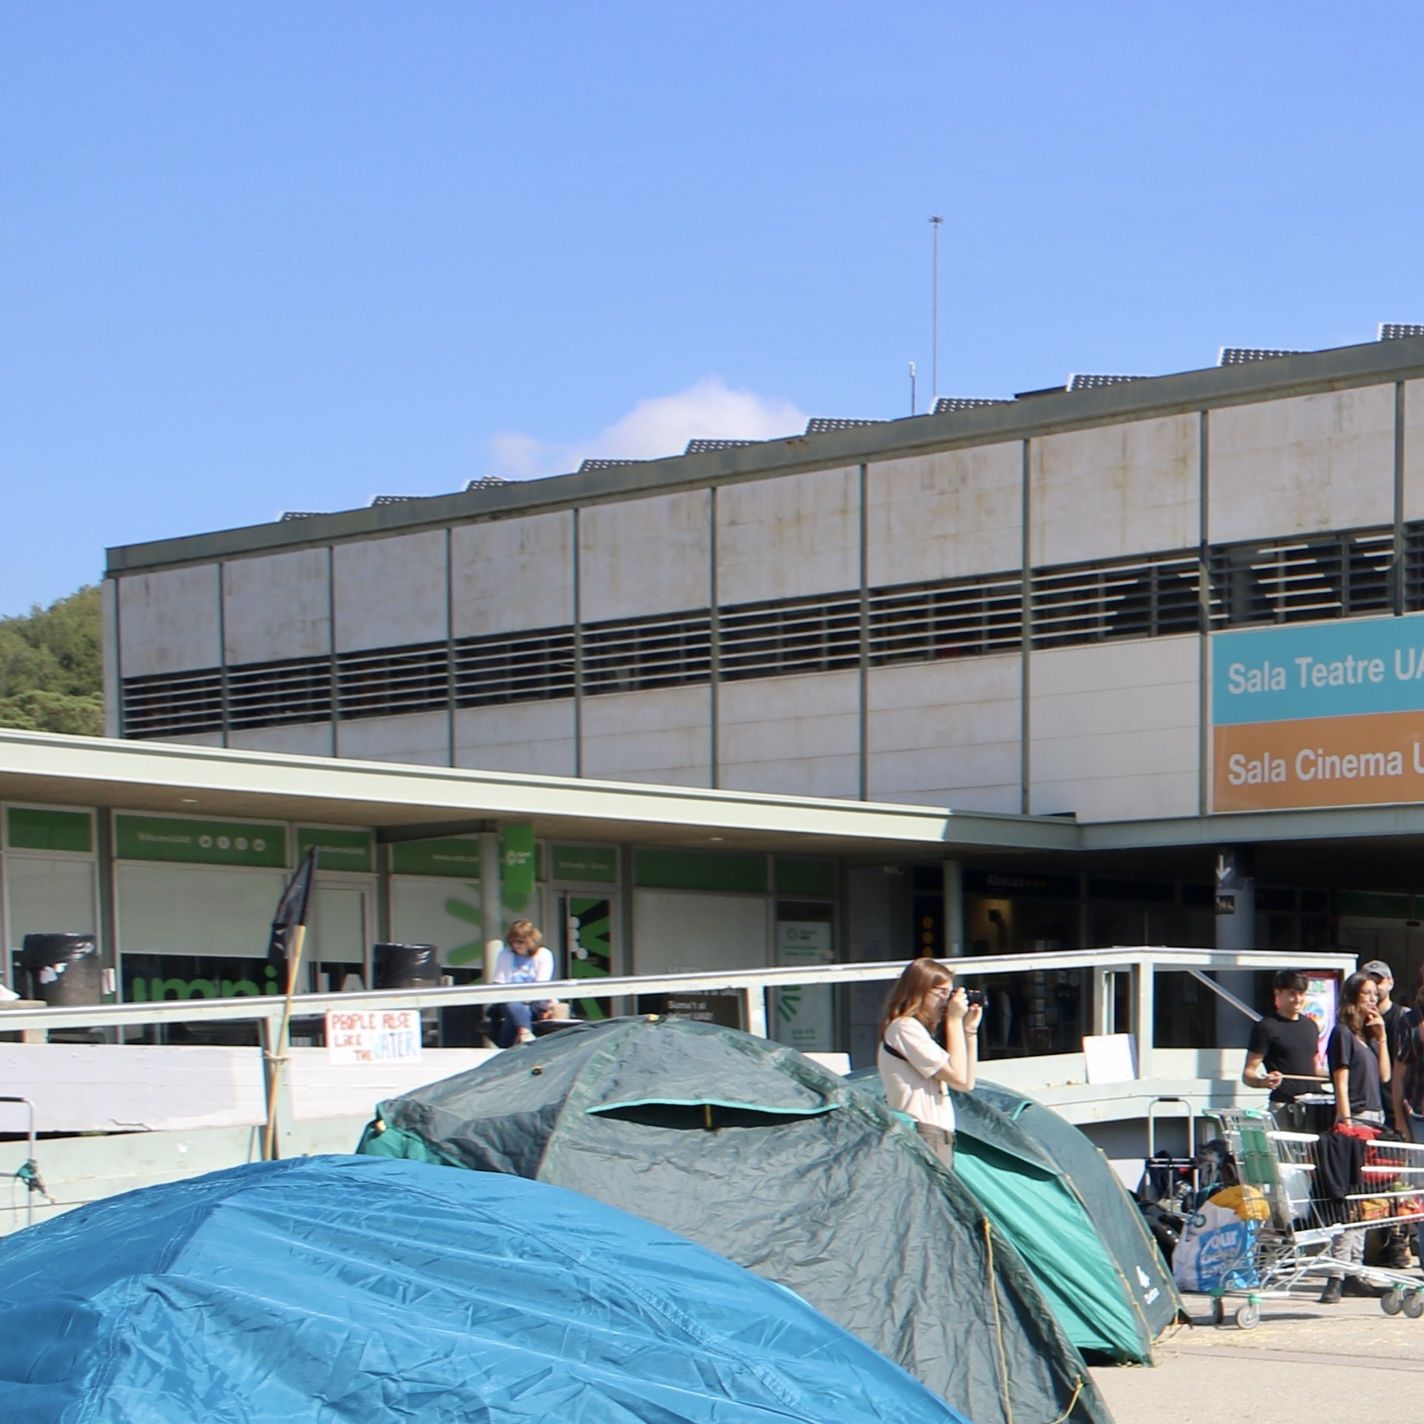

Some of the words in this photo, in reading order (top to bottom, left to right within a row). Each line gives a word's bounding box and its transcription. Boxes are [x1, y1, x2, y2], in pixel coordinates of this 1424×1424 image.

[1227, 661, 1287, 695] Sala
[1295, 654, 1386, 690] Teatre
[1227, 752, 1287, 786] Sala
[1295, 747, 1404, 782] Cinema
[332, 1013, 376, 1030] PEOPLE
